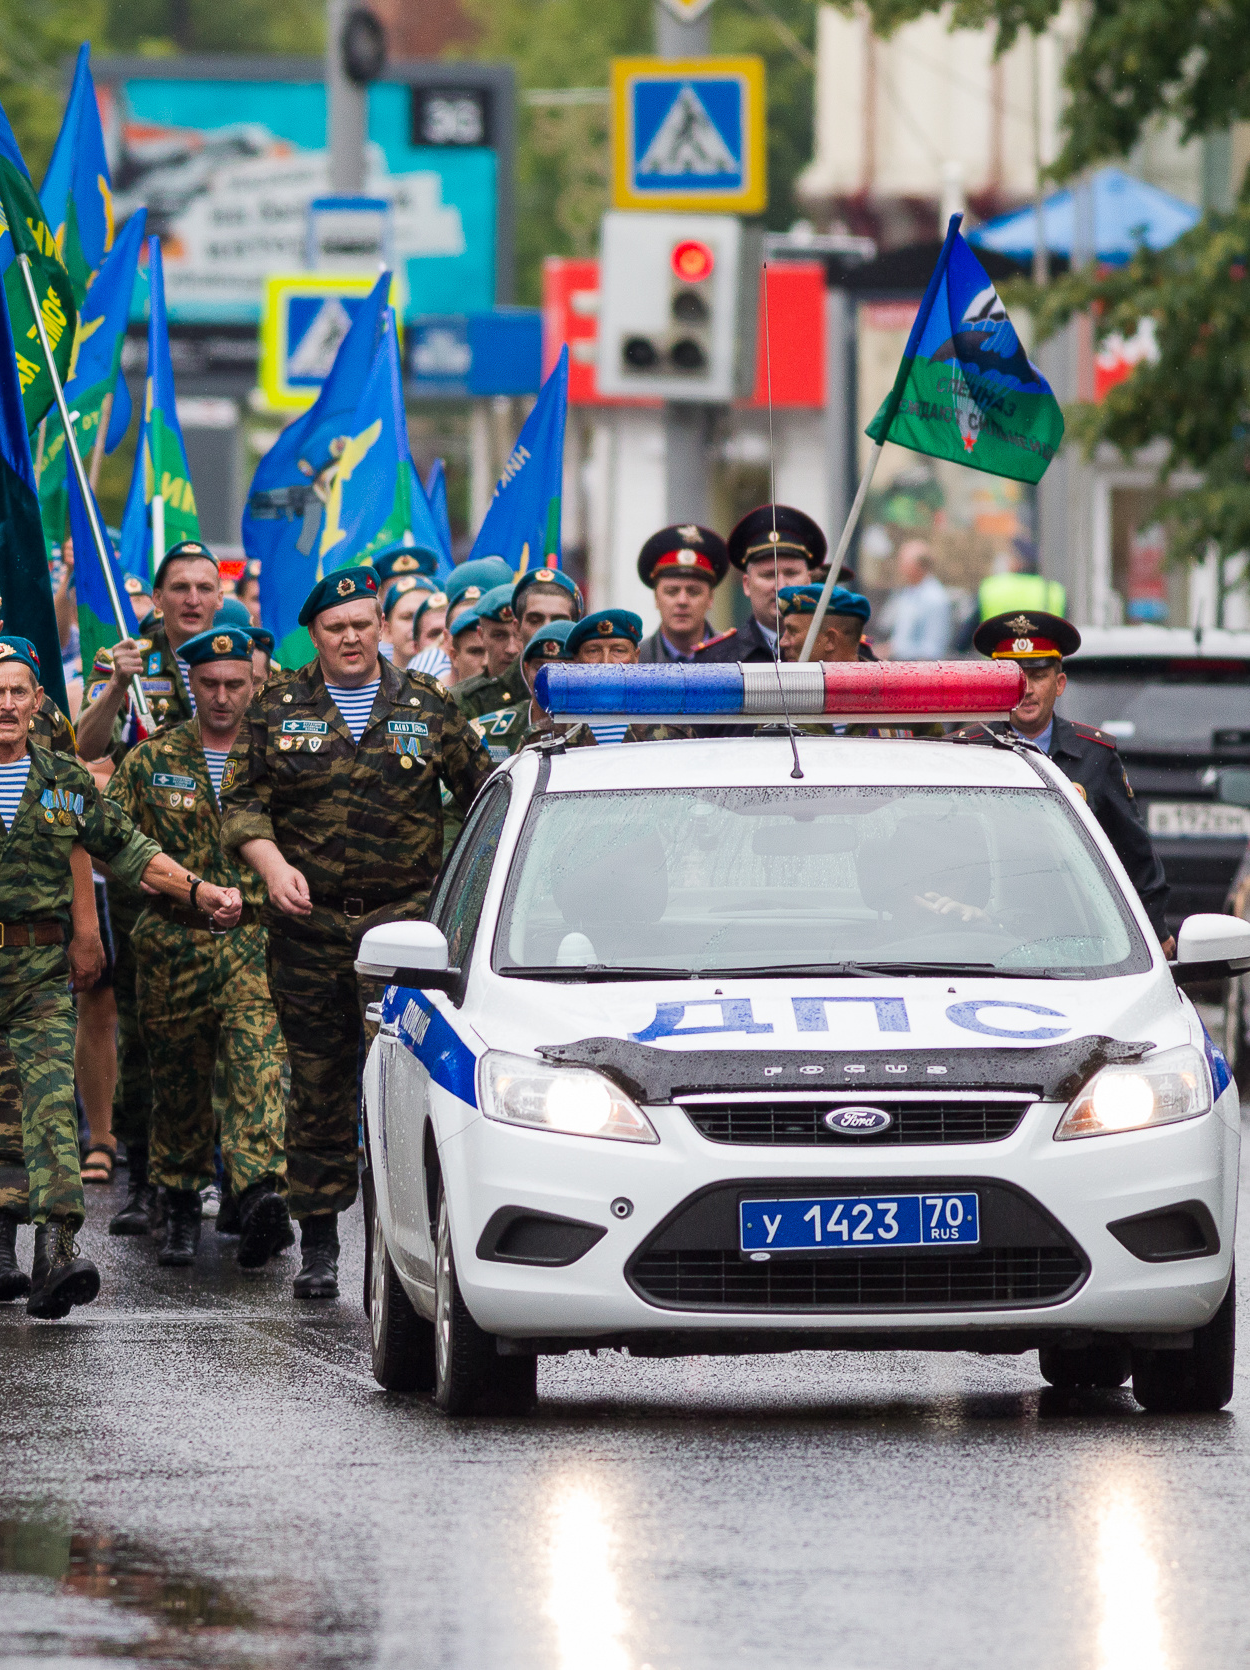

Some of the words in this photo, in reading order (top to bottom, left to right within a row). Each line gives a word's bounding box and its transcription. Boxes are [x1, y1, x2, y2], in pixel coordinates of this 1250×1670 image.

[627, 997, 1072, 1043] ДПС
[764, 1063, 947, 1076] FOCUS
[840, 1110, 876, 1128] Ford
[803, 1202, 899, 1242] 1423
[925, 1198, 964, 1227] 70
[931, 1228, 959, 1240] RUS
